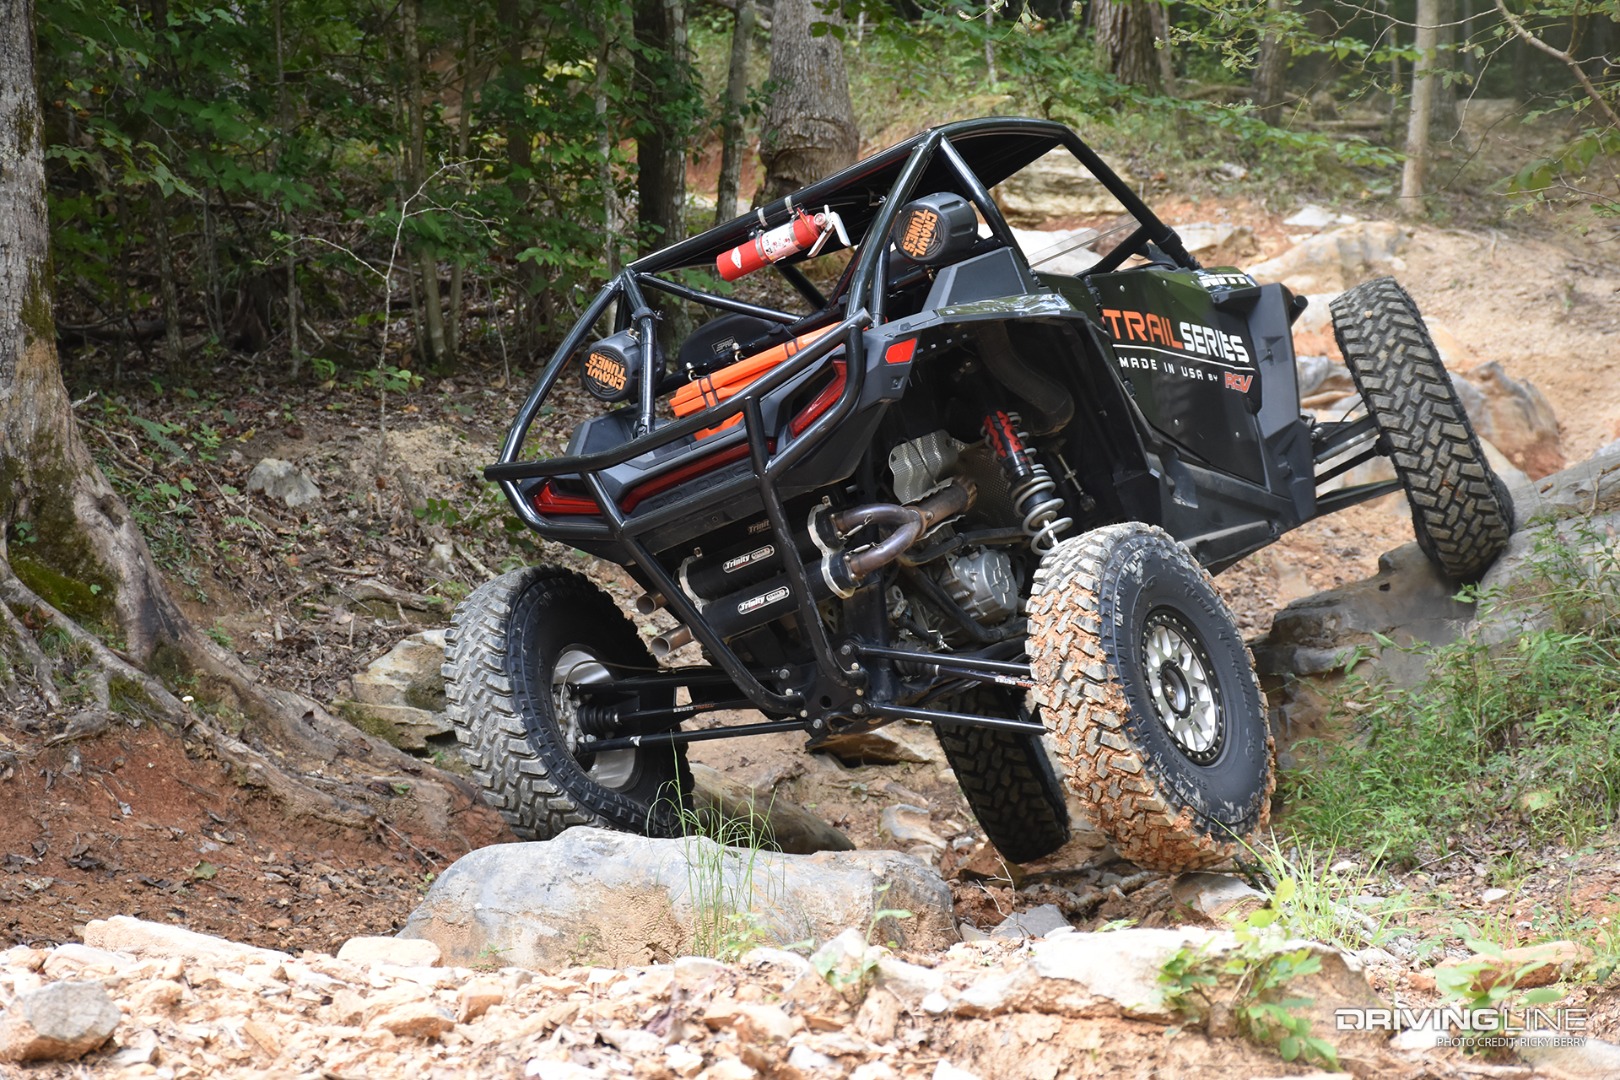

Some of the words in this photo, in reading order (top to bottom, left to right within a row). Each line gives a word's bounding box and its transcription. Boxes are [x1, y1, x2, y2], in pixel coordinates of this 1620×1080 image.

[903, 209, 929, 252] TUNES
[912, 212, 938, 257] CRAWL
[585, 362, 625, 391] CRAWL
[589, 353, 627, 381] TUNES
[1119, 356, 1158, 370] MADE
[1163, 362, 1176, 374] IN
[1181, 366, 1204, 381] USA
[1208, 373, 1218, 382] BY
[724, 554, 750, 570] Trinity
[739, 596, 765, 611] Trinity
